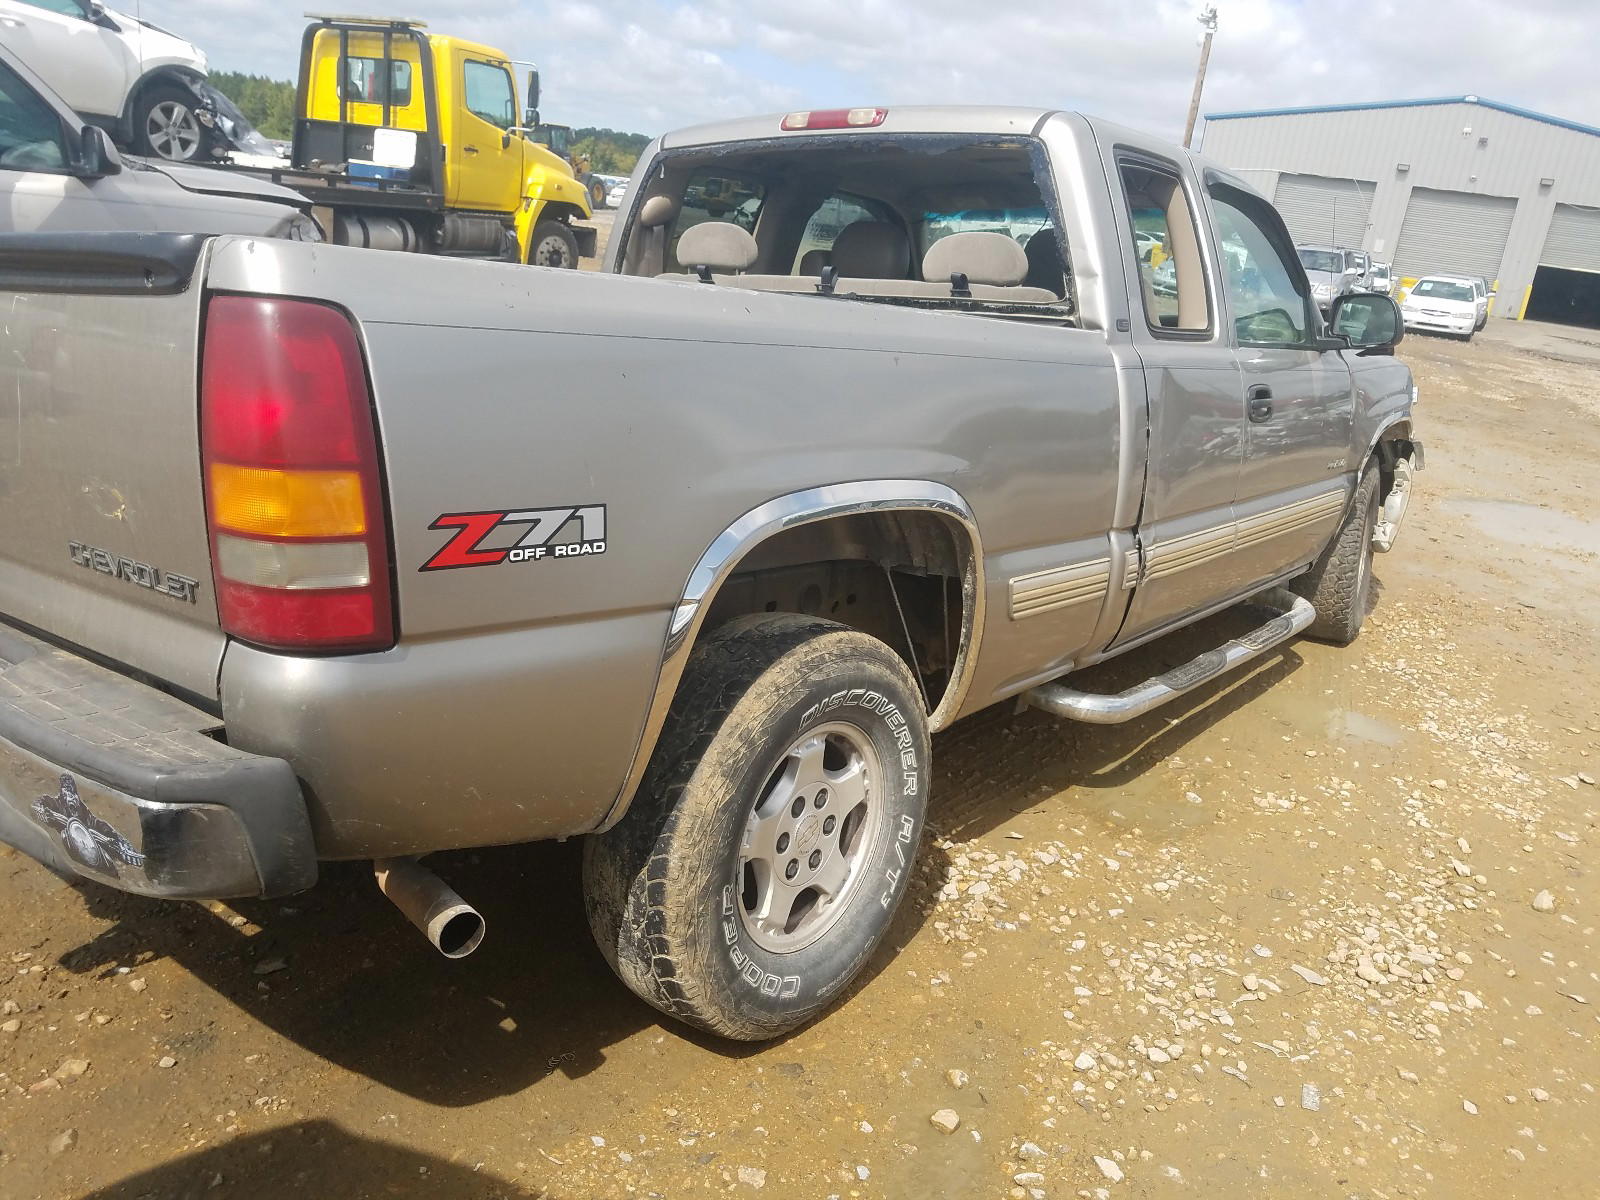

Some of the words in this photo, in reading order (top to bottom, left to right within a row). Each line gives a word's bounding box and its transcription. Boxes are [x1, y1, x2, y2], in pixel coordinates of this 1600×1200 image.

[419, 504, 606, 571] Z71
[509, 547, 546, 562] OFF
[555, 541, 606, 556] ROAD
[69, 540, 199, 603] CHEVROLET
[798, 689, 918, 796] DISCOVERER
[723, 883, 801, 998] COOPER
